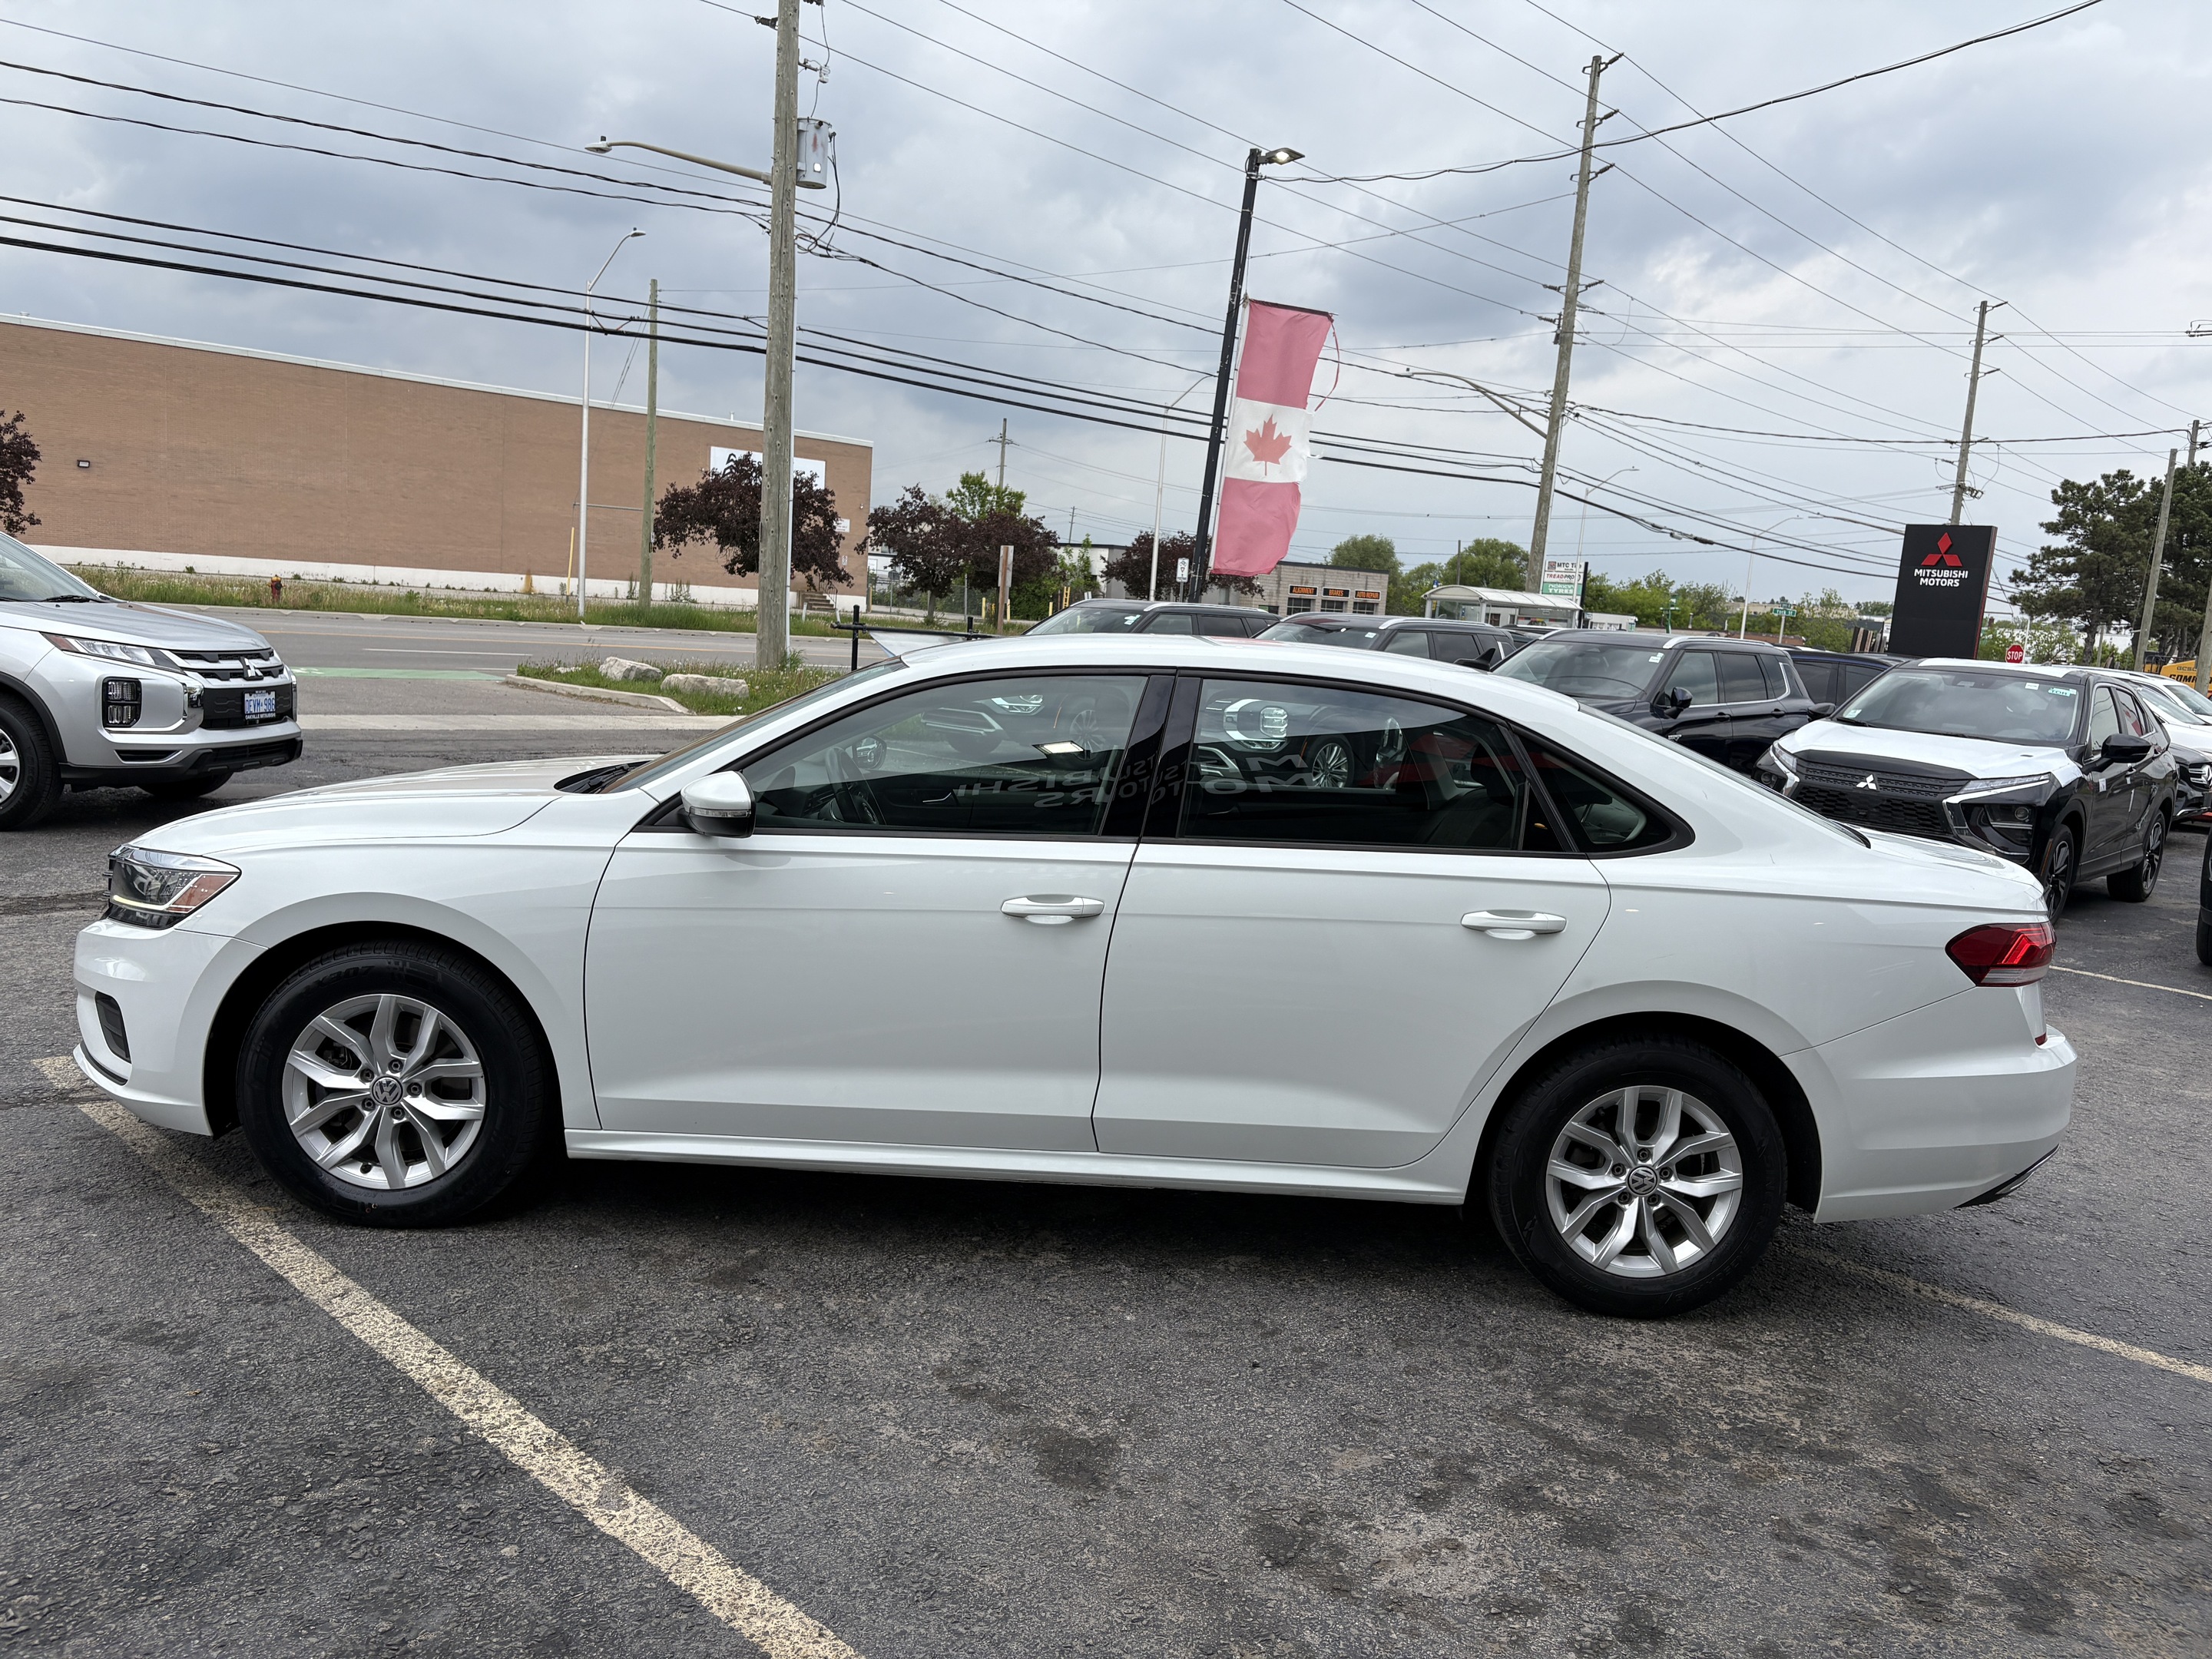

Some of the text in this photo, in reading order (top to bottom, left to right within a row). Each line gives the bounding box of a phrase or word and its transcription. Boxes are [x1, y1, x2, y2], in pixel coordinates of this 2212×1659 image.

[1914, 568, 1969, 578] MITSUBISHI
[1919, 578, 1960, 587] MOTORS
[2007, 651, 2023, 661] STOP
